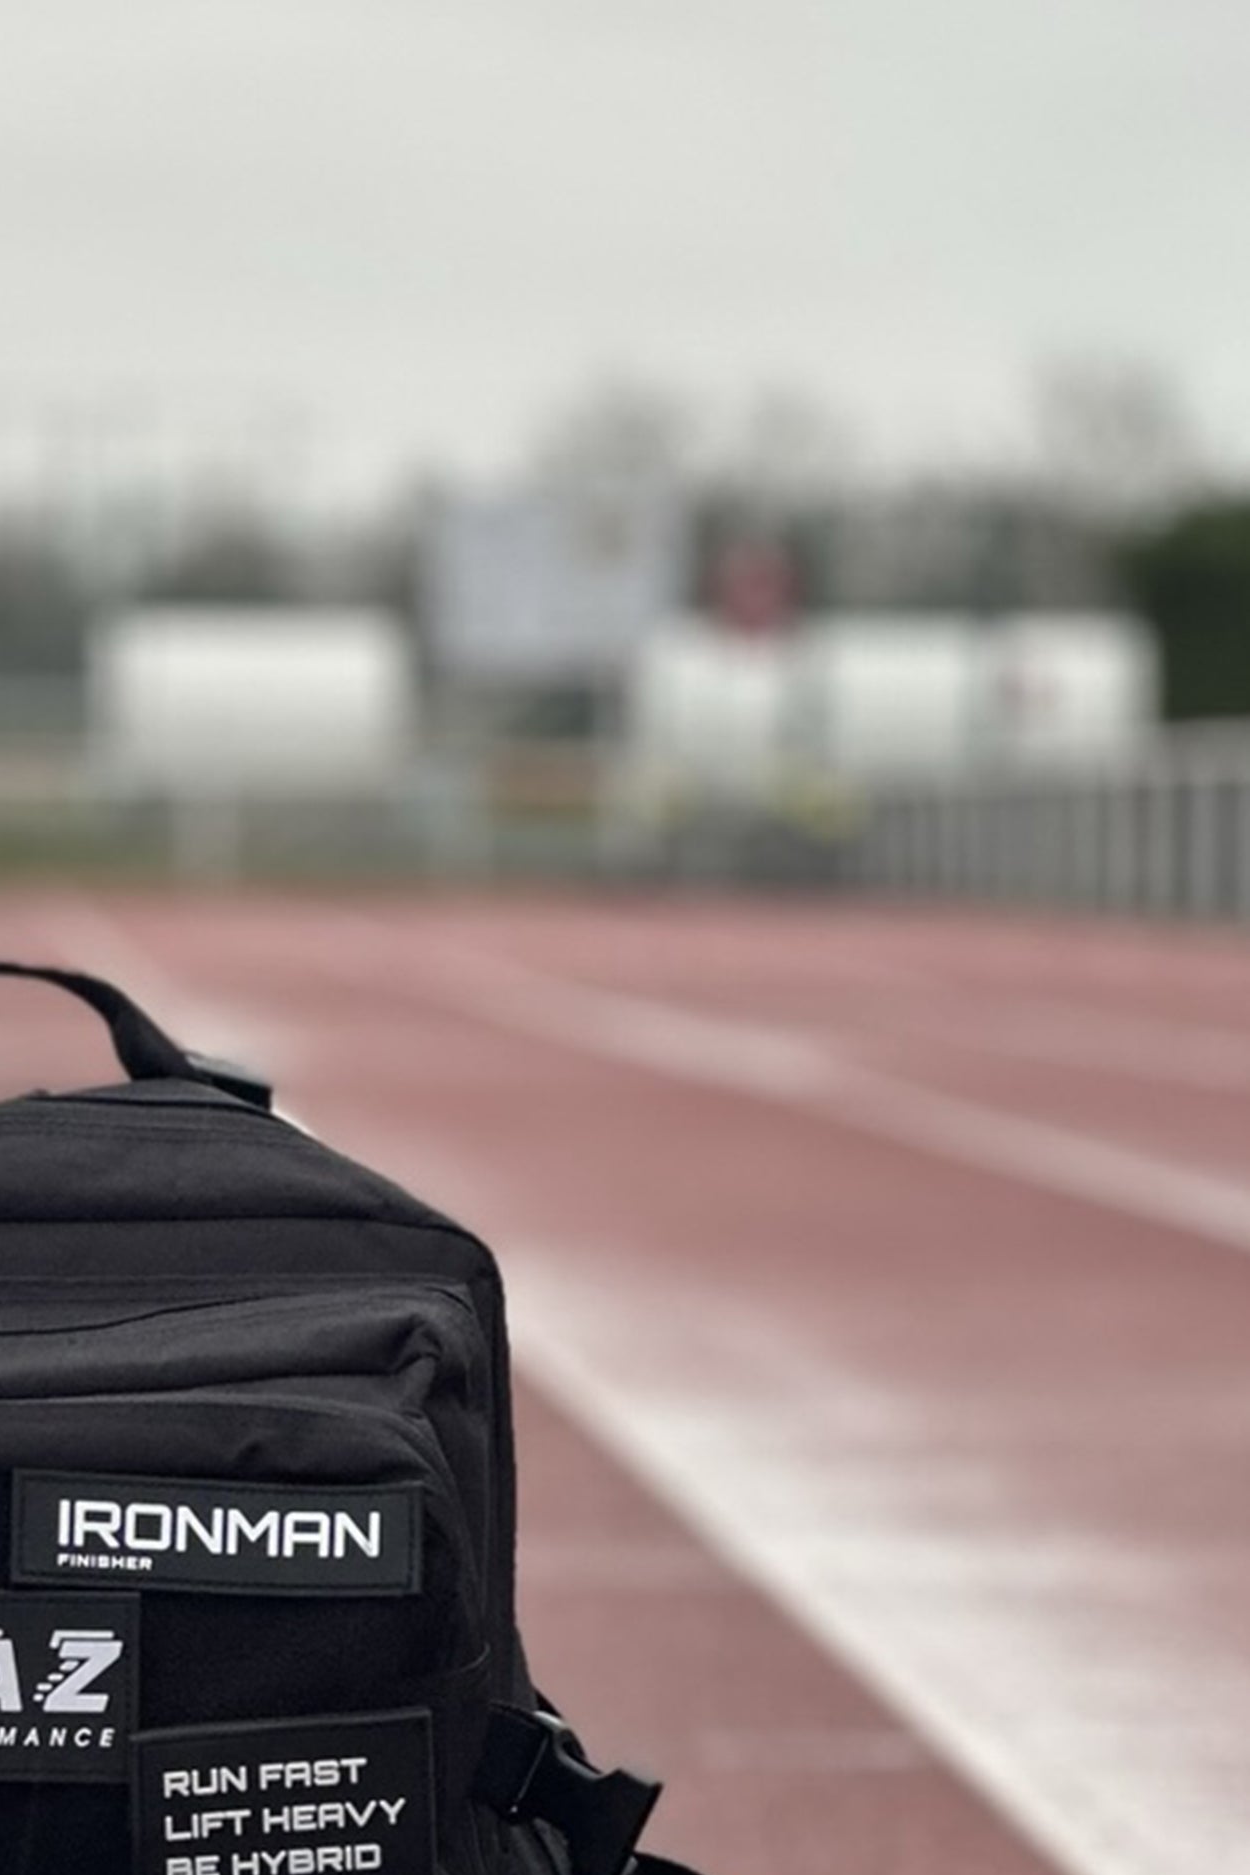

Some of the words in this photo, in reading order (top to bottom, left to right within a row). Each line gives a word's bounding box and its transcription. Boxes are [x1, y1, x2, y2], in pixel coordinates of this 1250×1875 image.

[57, 1499, 381, 1558] IRONMAN
[56, 1553, 154, 1571] FINISHER
[163, 1765, 248, 1799] RUN
[258, 1757, 368, 1791] FAST
[164, 1808, 252, 1842] LIFT
[261, 1797, 406, 1834] HEAVY
